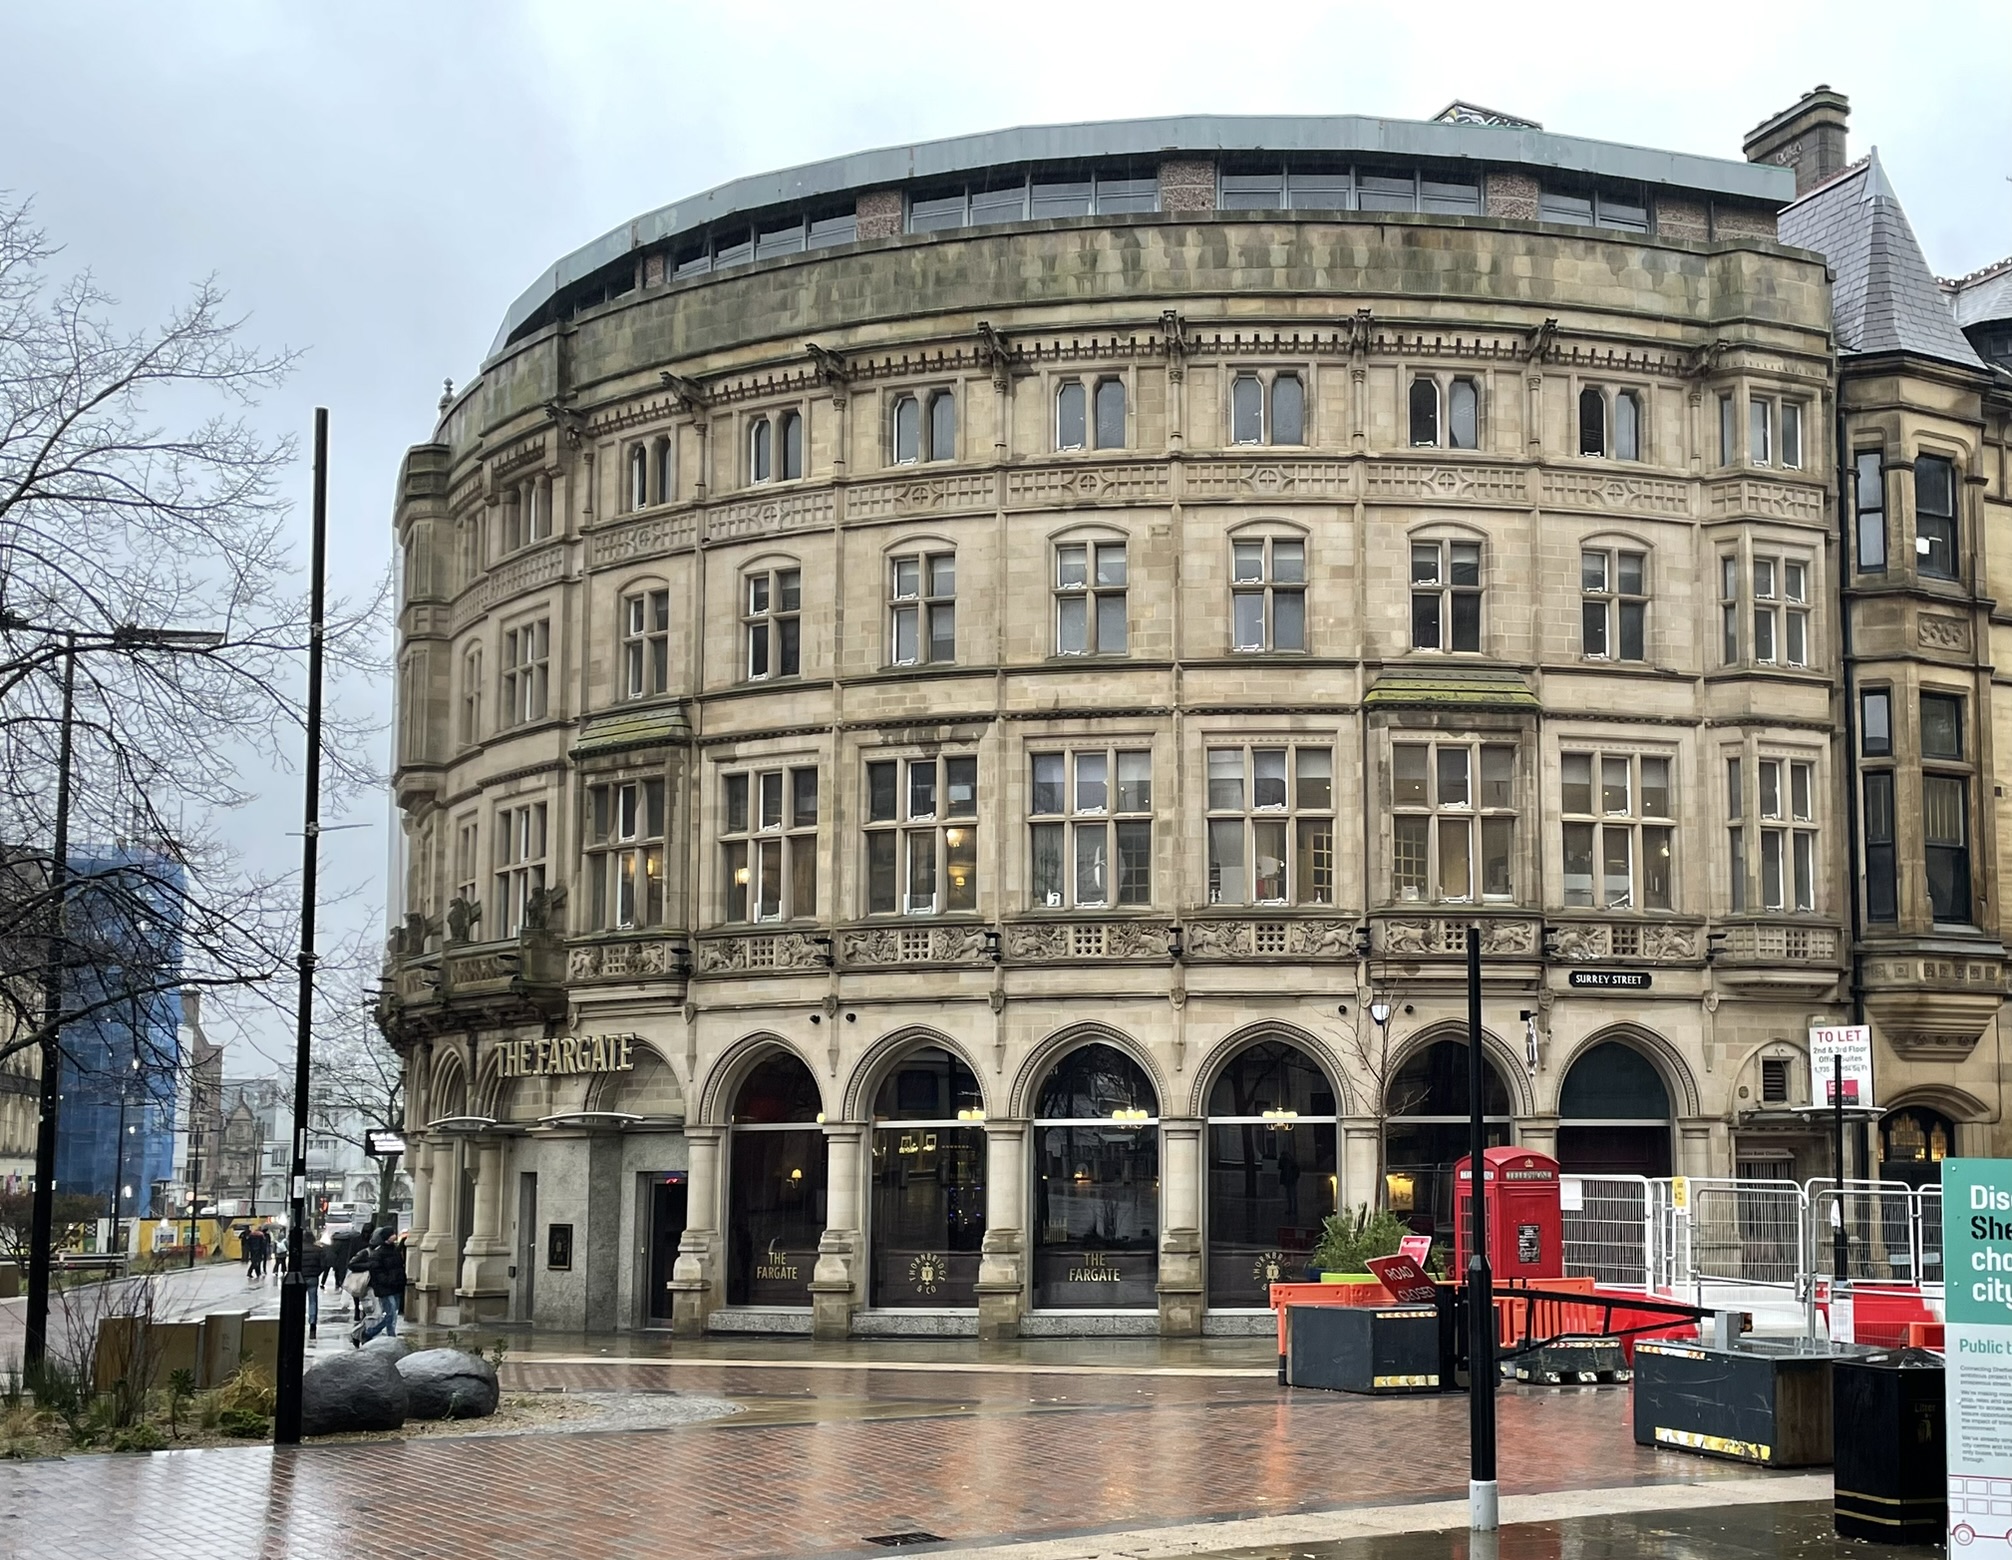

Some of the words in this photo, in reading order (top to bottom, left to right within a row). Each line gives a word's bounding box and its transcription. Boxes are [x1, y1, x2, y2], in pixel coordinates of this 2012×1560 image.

[1575, 974, 1610, 984] SURREY
[1612, 975, 1642, 985] STREET
[1817, 1031, 1833, 1043] TO
[1838, 1030, 1861, 1042] LET
[495, 1041, 533, 1077] THE
[533, 1032, 635, 1075] FARGATE
[1848, 1045, 1867, 1053] Floor
[1819, 1055, 1836, 1063] Offic
[1506, 1171, 1552, 1179] TELEPHONE
[769, 1252, 786, 1265] THE
[1084, 1253, 1106, 1266] THE
[757, 1266, 798, 1280] FARGATE
[1069, 1268, 1121, 1282] FARGATE
[1384, 1266, 1415, 1281] ROAD
[1398, 1286, 1436, 1301] CLOSED
[1960, 1338, 2003, 1354] Public
